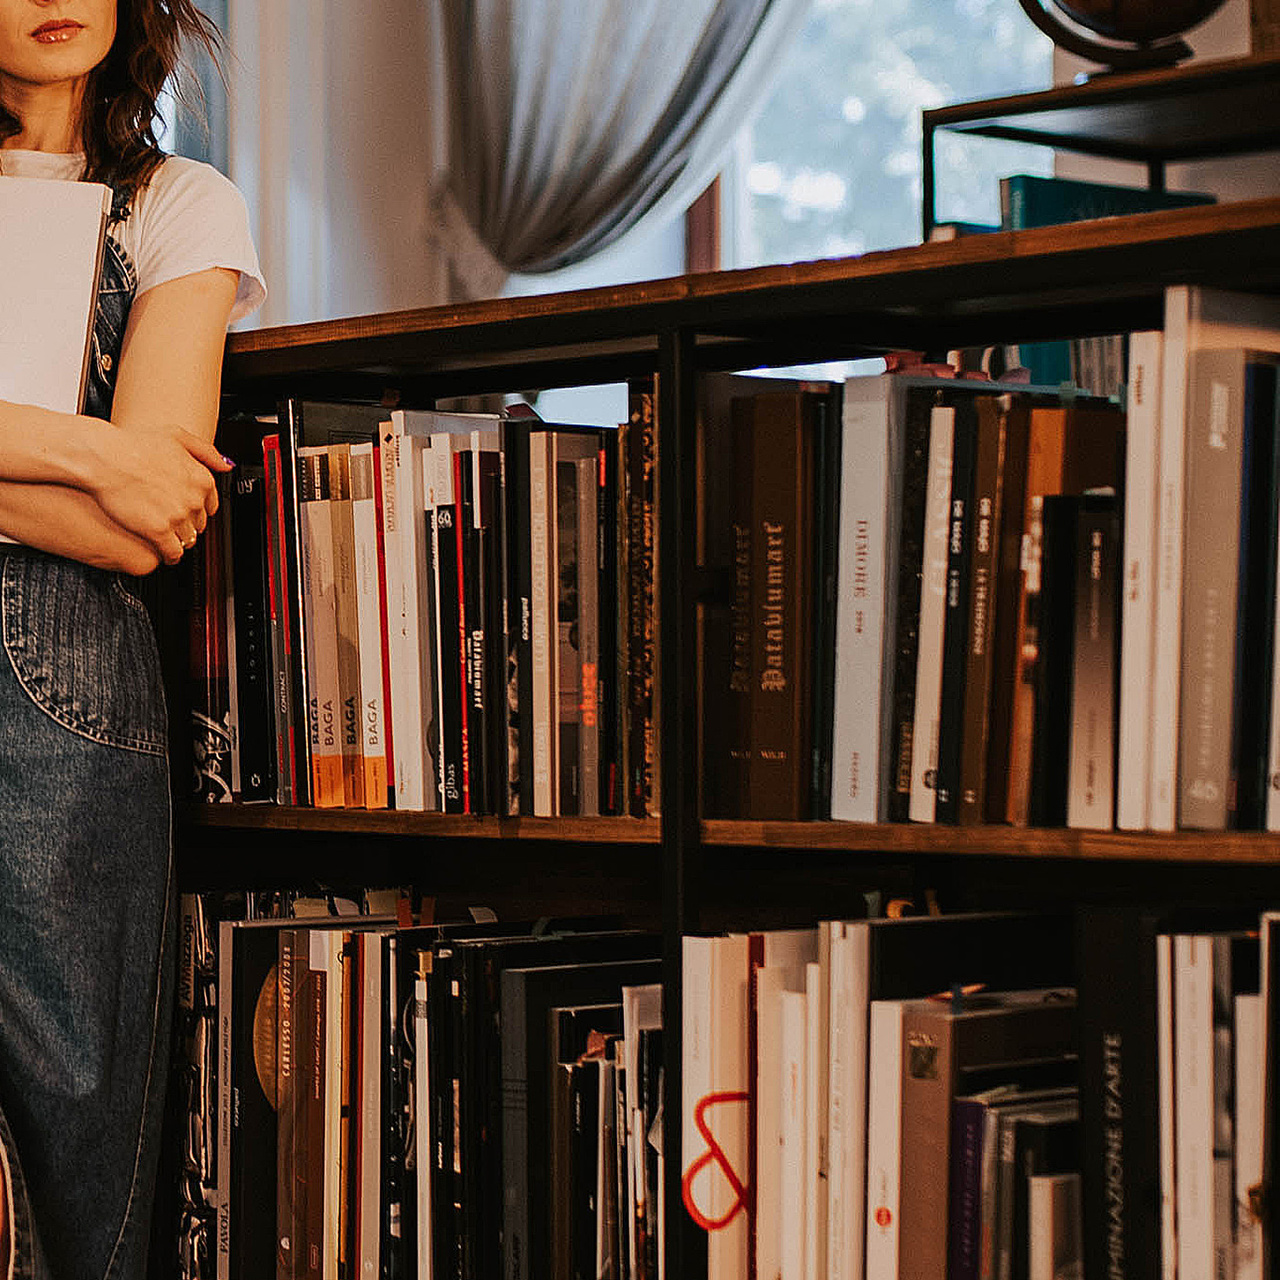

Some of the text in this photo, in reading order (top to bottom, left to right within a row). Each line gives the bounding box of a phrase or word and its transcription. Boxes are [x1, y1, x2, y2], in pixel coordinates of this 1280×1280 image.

[324, 700, 334, 746] BAGA
[345, 695, 356, 745] BAGA
[368, 699, 379, 746] BAGA
[447, 763, 459, 800] gibas
[1103, 1032, 1123, 1121] D'ARTE
